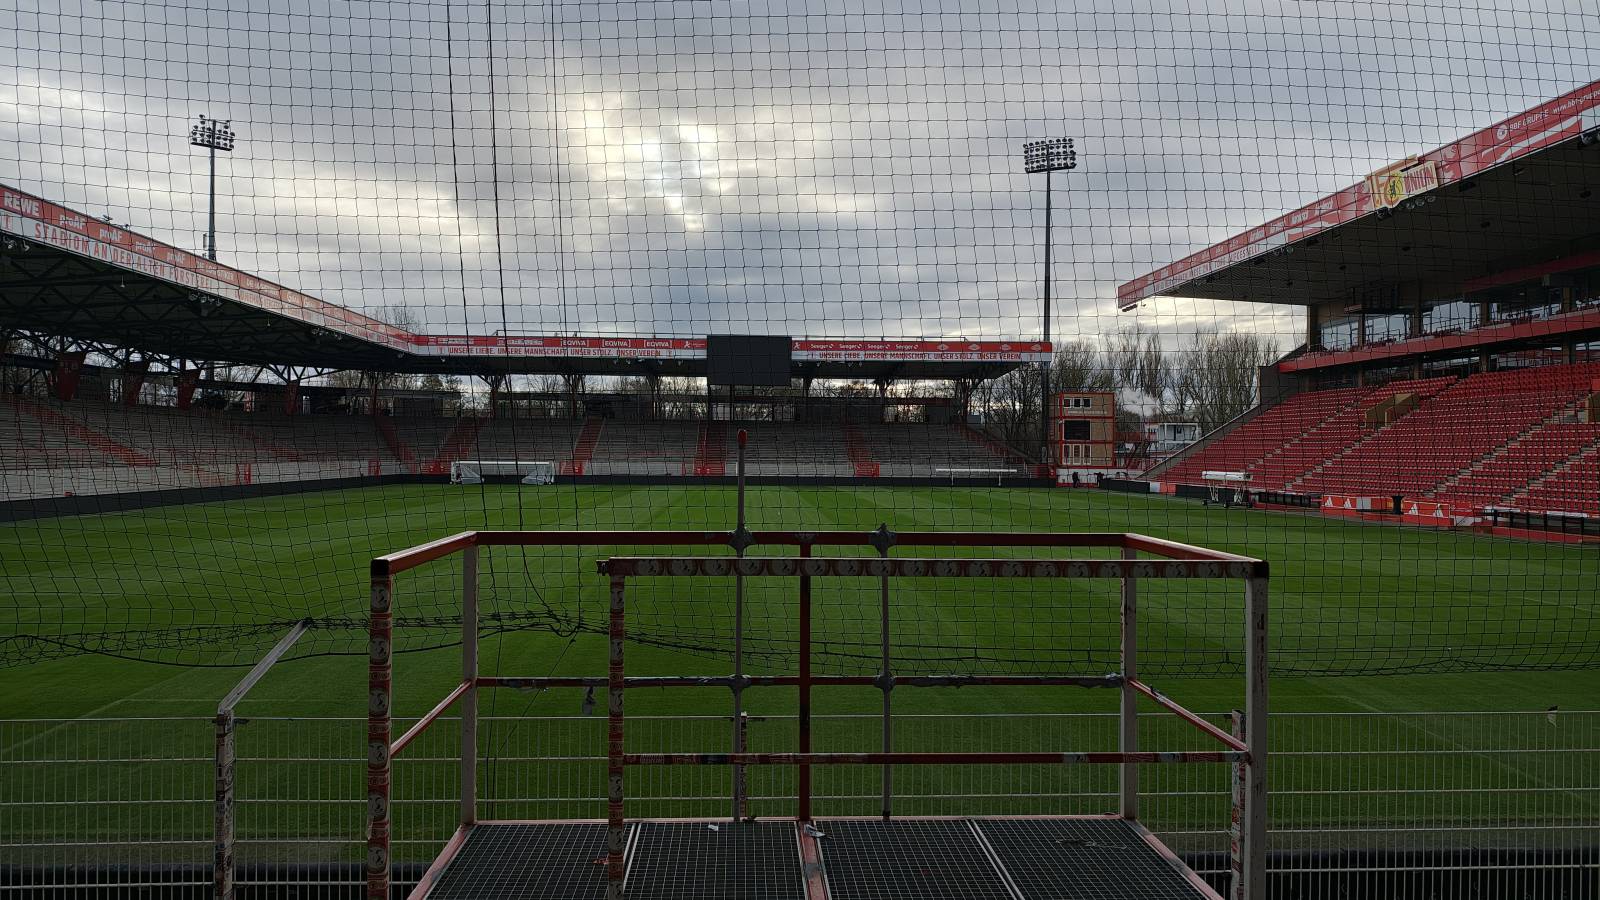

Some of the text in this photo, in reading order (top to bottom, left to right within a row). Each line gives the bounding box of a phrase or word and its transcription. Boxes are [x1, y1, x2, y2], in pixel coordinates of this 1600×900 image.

[1523, 109, 1549, 126] GRUPPE
[1404, 165, 1435, 194] UNION
[4, 191, 40, 217] REWE
[35, 222, 89, 254] STADION
[93, 241, 108, 260] AN
[112, 247, 132, 265] DER
[136, 255, 164, 276] ALTEN
